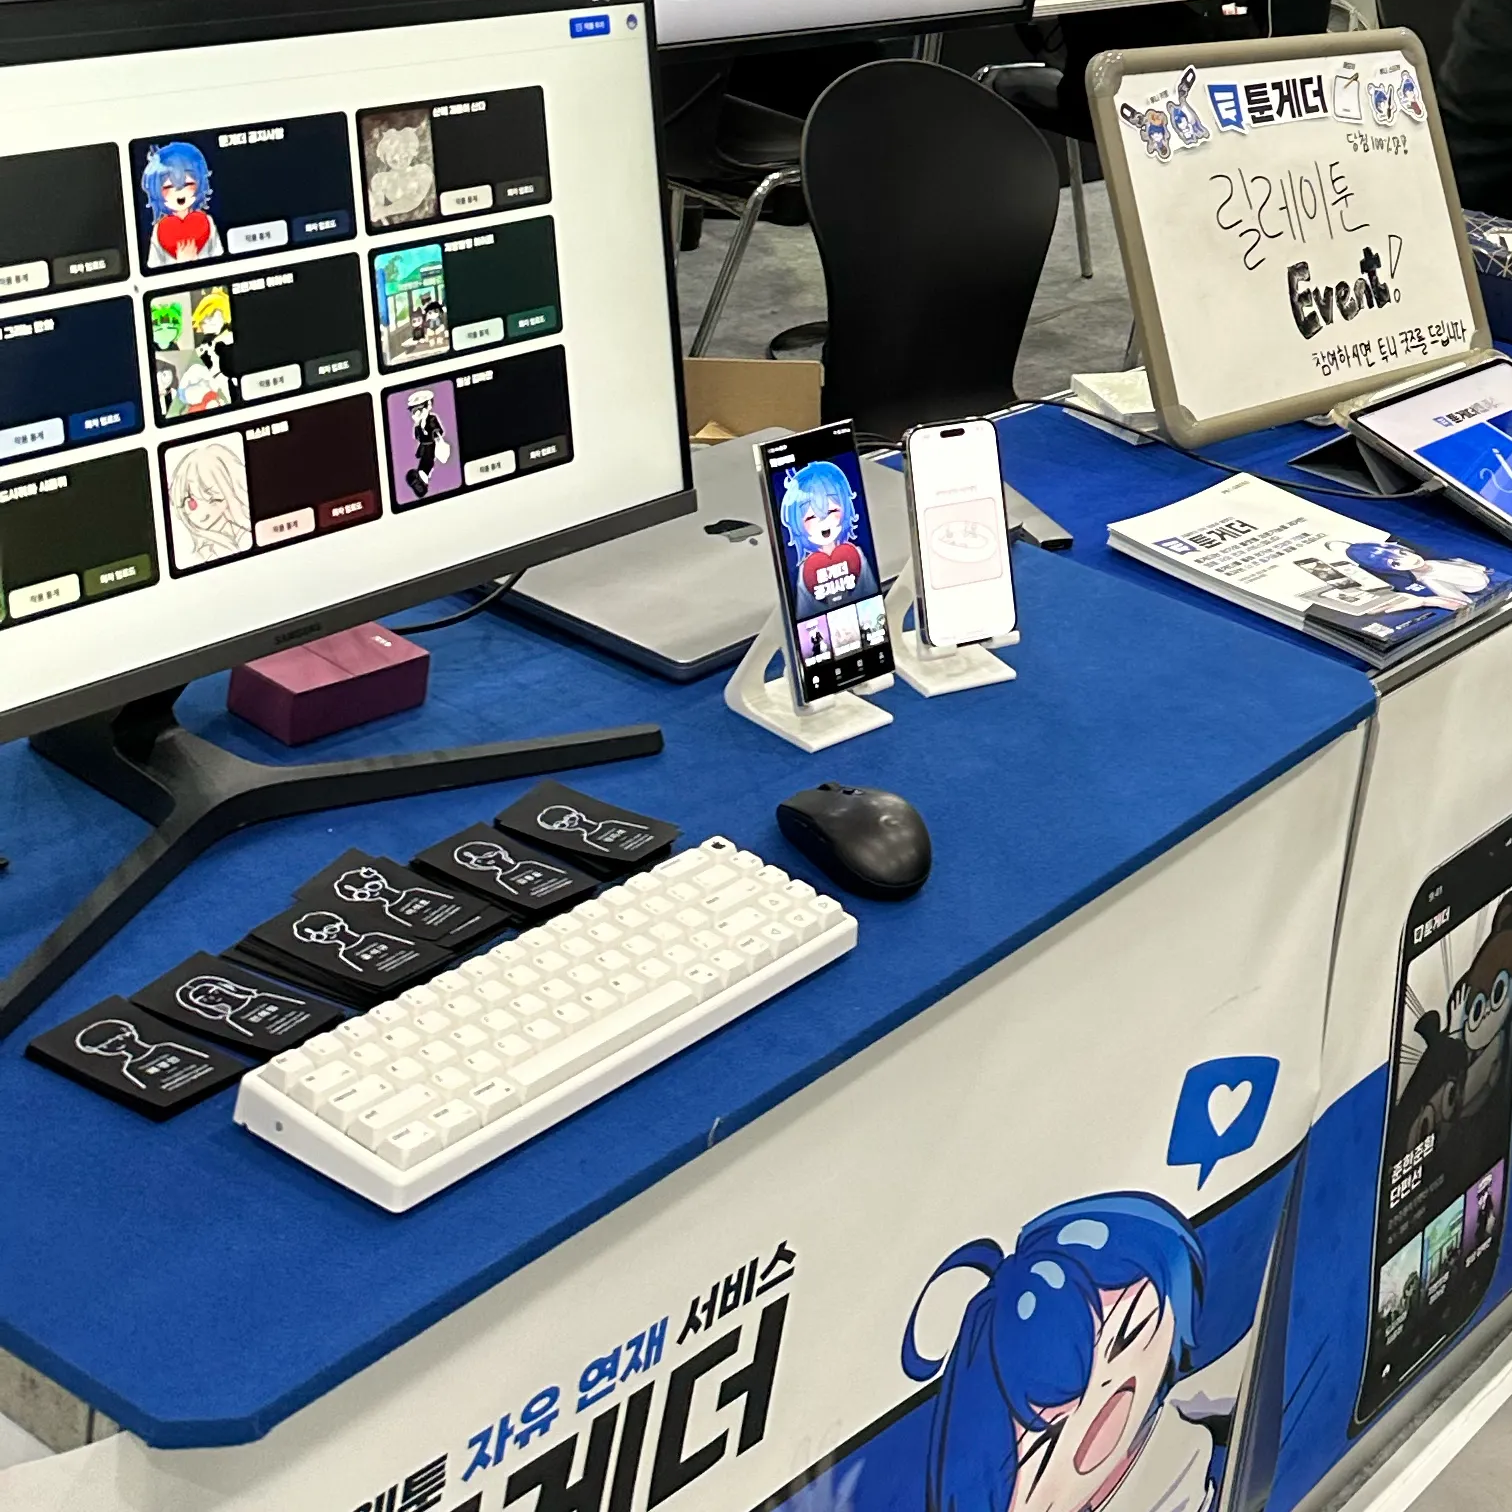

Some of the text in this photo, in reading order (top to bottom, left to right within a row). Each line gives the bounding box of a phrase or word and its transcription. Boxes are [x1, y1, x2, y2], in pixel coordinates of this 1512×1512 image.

[1243, 74, 1329, 124] 툰게더
[1209, 160, 1371, 272] 릴레이툰
[1287, 234, 1405, 341] Event!
[462, 1385, 560, 1482] 자유
[575, 1315, 670, 1414] 연재
[677, 1240, 797, 1345] 서비스
